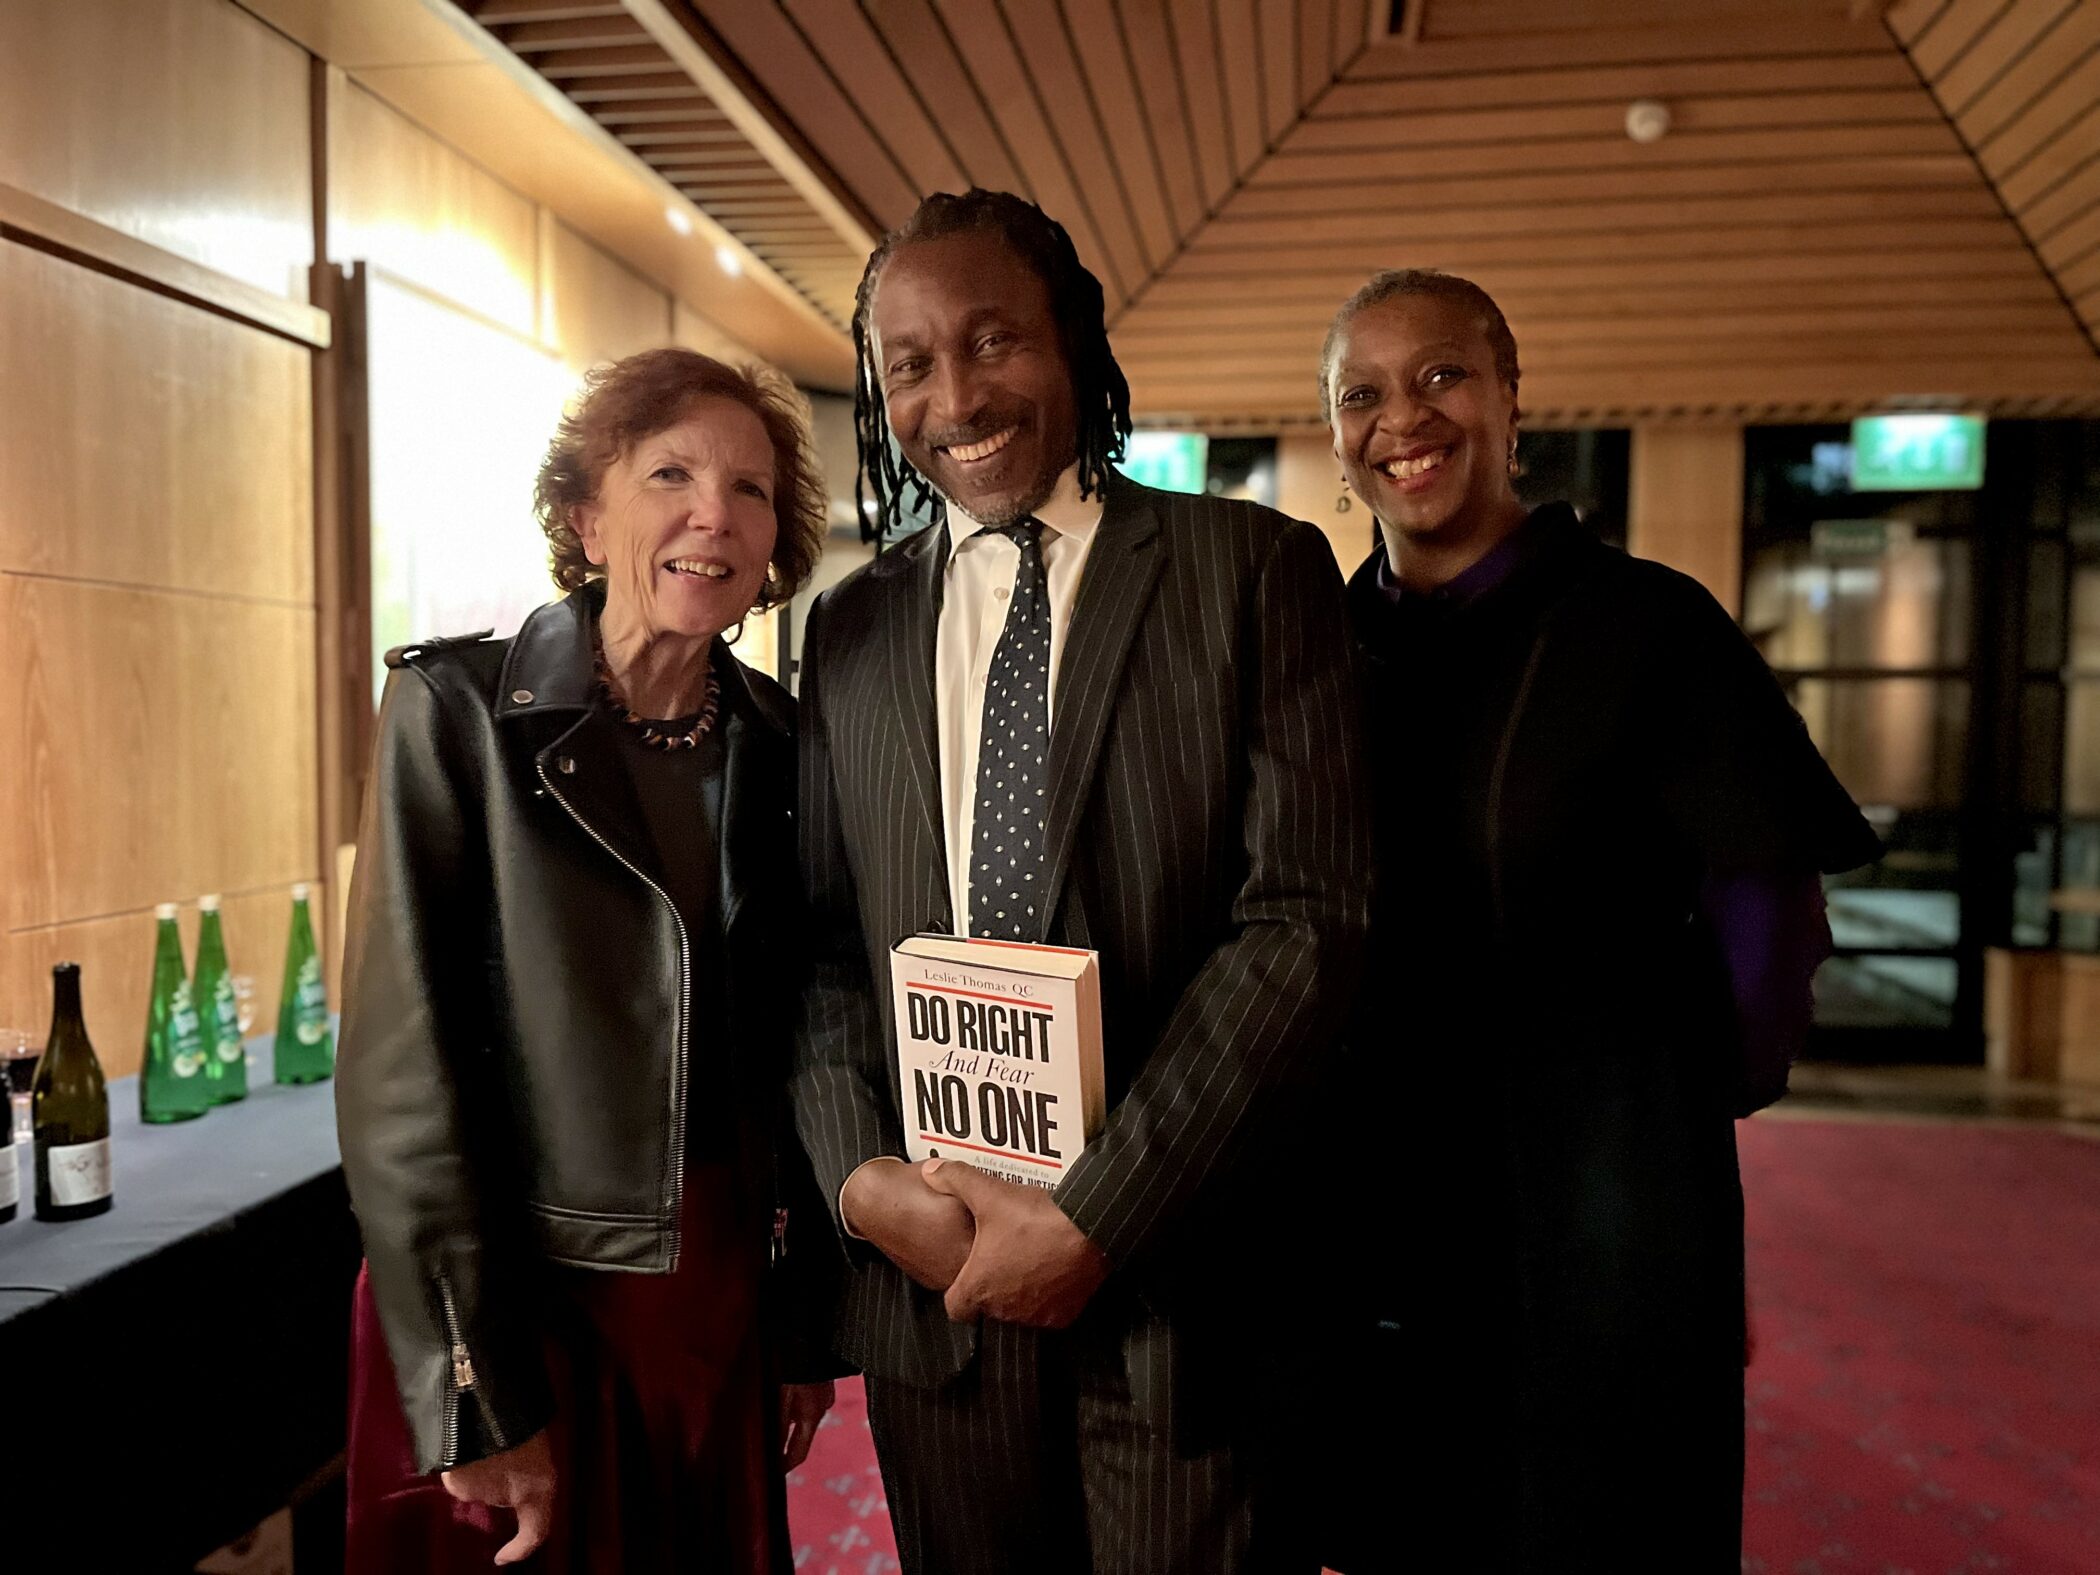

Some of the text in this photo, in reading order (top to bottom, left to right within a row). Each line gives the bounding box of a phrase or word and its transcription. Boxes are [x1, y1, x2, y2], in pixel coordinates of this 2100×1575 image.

[924, 968, 1034, 998] Leslie Thomas QC
[907, 991, 1053, 1063] DO RIGHT
[929, 1050, 1035, 1085] And Fear
[914, 1068, 1062, 1159] NO ONE
[983, 1157, 997, 1168] life
[999, 1160, 1039, 1177] dedicated
[1040, 1171, 1049, 1179] to
